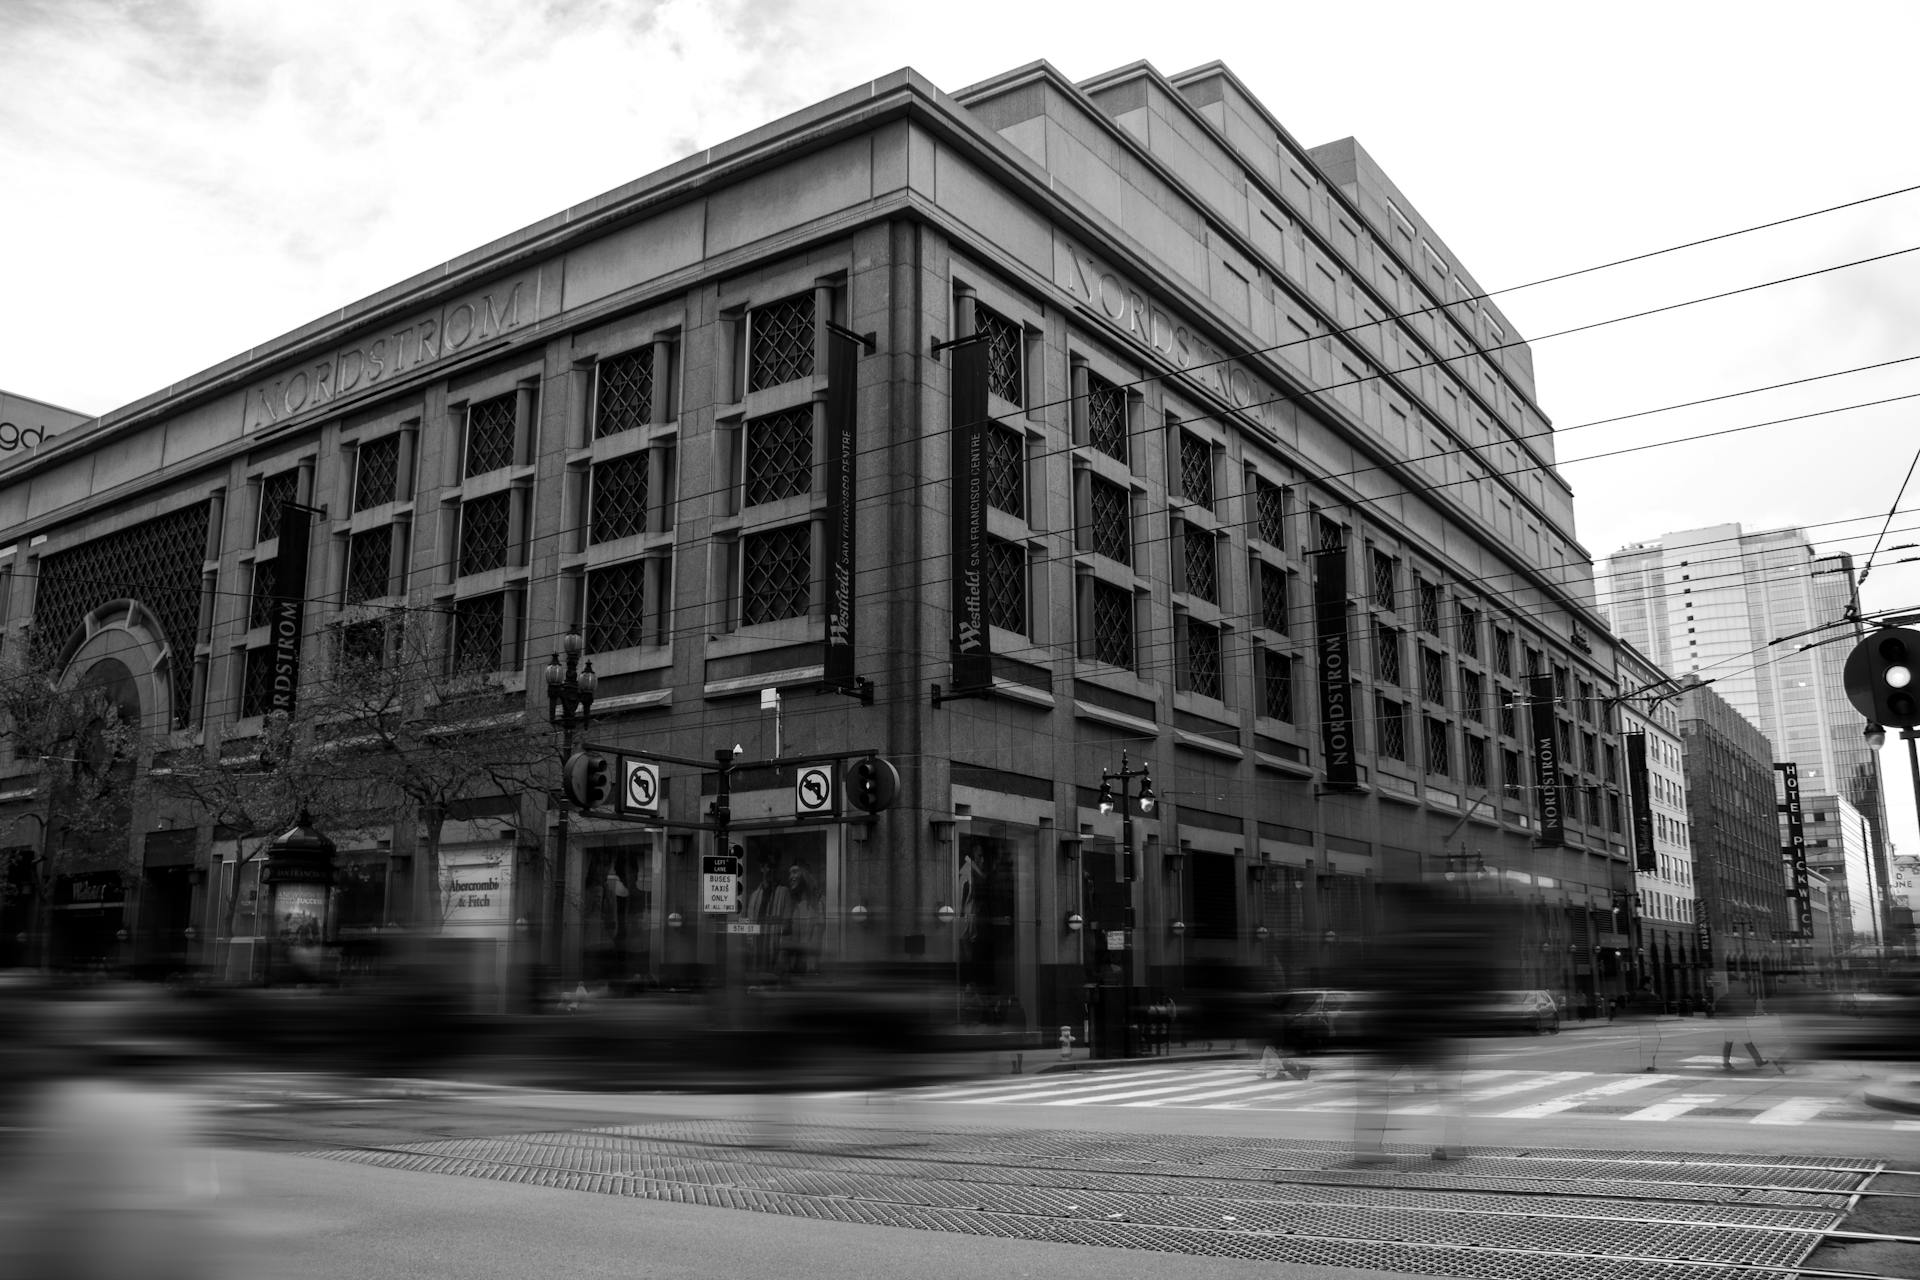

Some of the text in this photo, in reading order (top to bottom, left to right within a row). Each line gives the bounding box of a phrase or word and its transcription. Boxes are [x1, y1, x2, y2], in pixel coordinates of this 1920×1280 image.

[254, 281, 524, 427] NORDSTROM
[1066, 242, 1278, 430] NORDSTROM
[0, 422, 57, 451] gd
[959, 432, 981, 653] Westfield SAN FRANCISCO CENTRE
[830, 562, 850, 647] Westfield
[842, 543, 850, 564] SAN
[271, 602, 298, 720] ORDSTROM
[1326, 636, 1349, 765] NORDSTROM
[1540, 738, 1558, 828] NORDSTROM
[468, 894, 490, 908] Fitch
[709, 875, 731, 883] BUSES
[711, 884, 729, 892] TAXIS
[711, 894, 729, 902] ONLY
[1786, 766, 1811, 937] HOTEL PICKWICK
